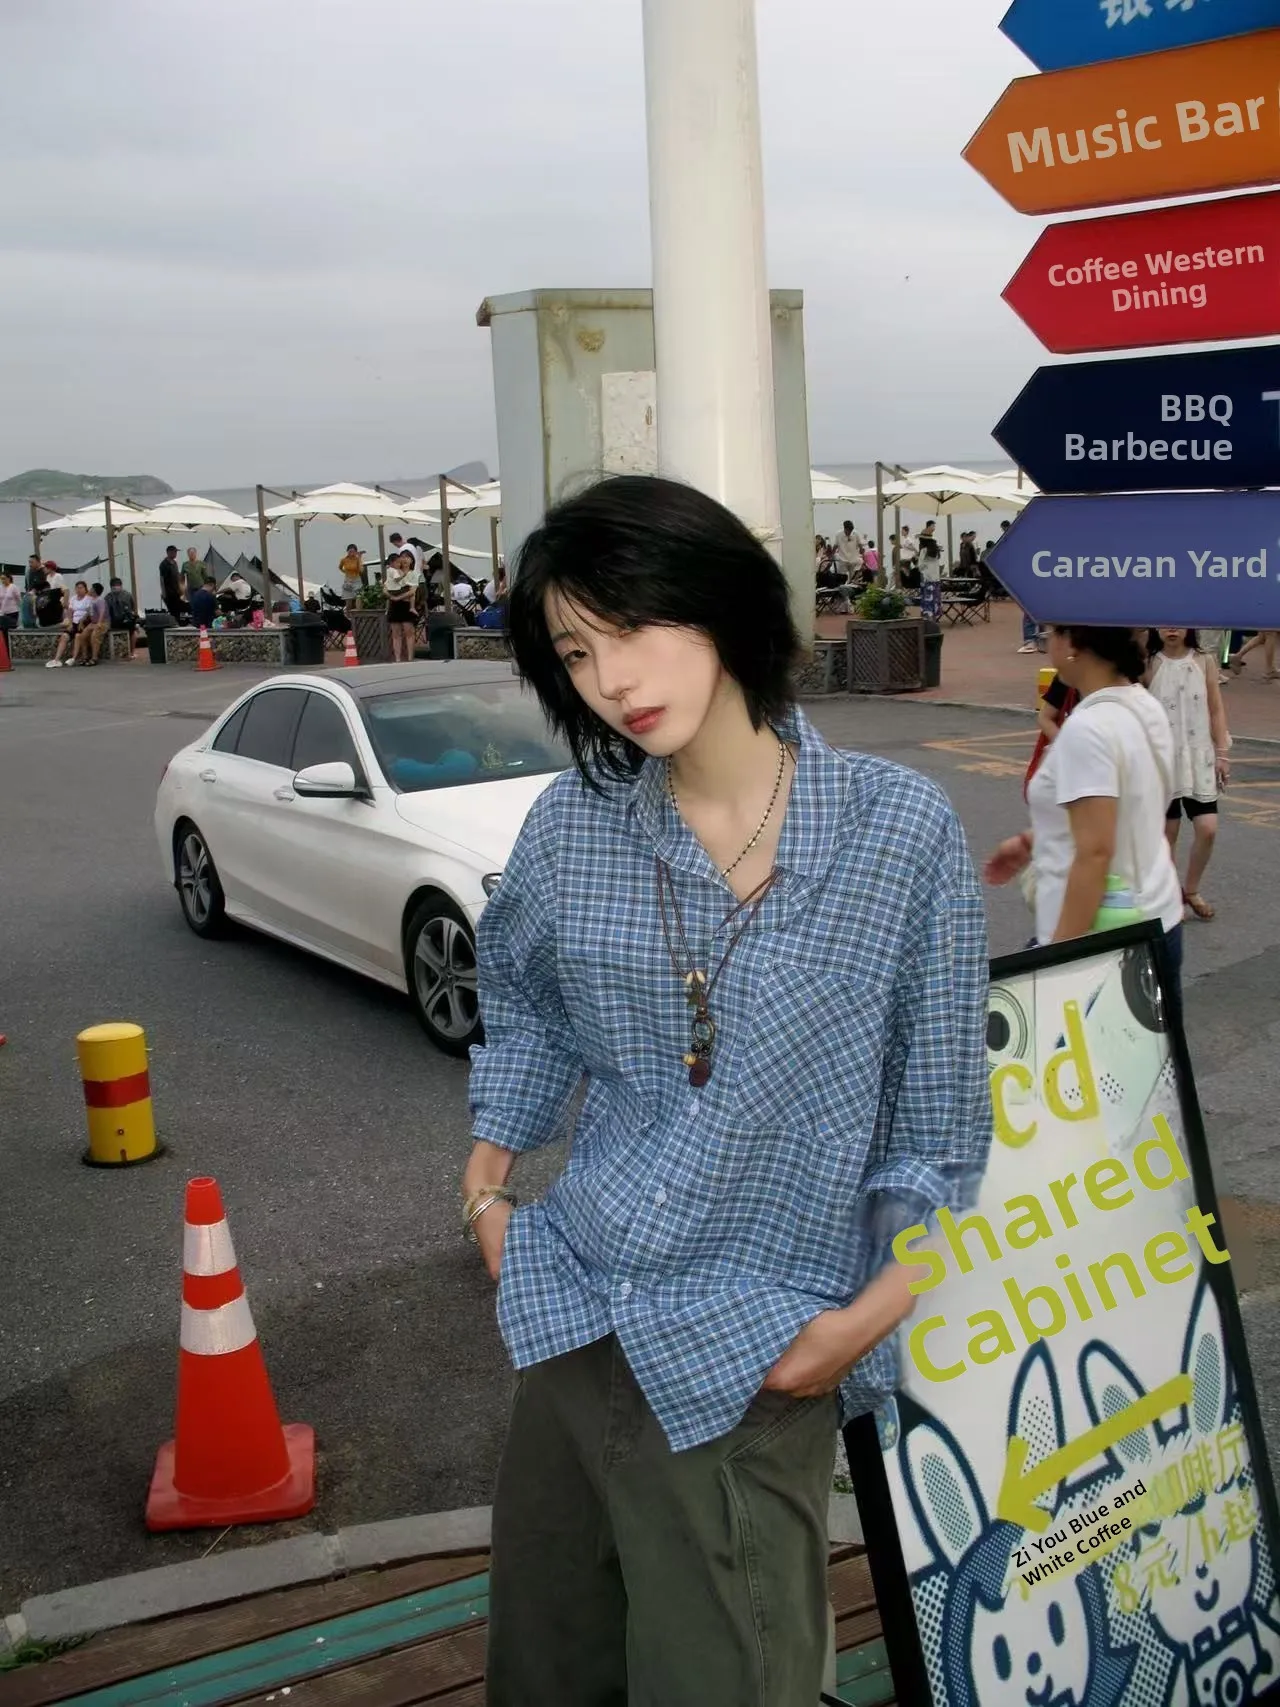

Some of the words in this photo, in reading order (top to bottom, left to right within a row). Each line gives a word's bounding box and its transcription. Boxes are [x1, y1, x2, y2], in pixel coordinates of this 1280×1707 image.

[1007, 108, 1162, 173] Music
[1175, 96, 1265, 143] Bar
[1048, 257, 1138, 287] Coffee
[1145, 244, 1265, 276] Western
[1111, 281, 1207, 312] Dining
[1161, 394, 1233, 427] BBQ
[1065, 431, 1233, 461] Barbecue
[1031, 550, 1176, 578] Caravan
[1187, 548, 1267, 578] Yard
[891, 1113, 1190, 1295] Shared
[908, 1205, 1231, 1383] Cabinet
[1011, 1546, 1032, 1568] Zi
[1031, 1529, 1068, 1554] You
[1068, 1505, 1110, 1534] Blue
[1113, 1479, 1147, 1509] and
[1021, 1550, 1075, 1586] White
[1076, 1517, 1132, 1554] Coffee
